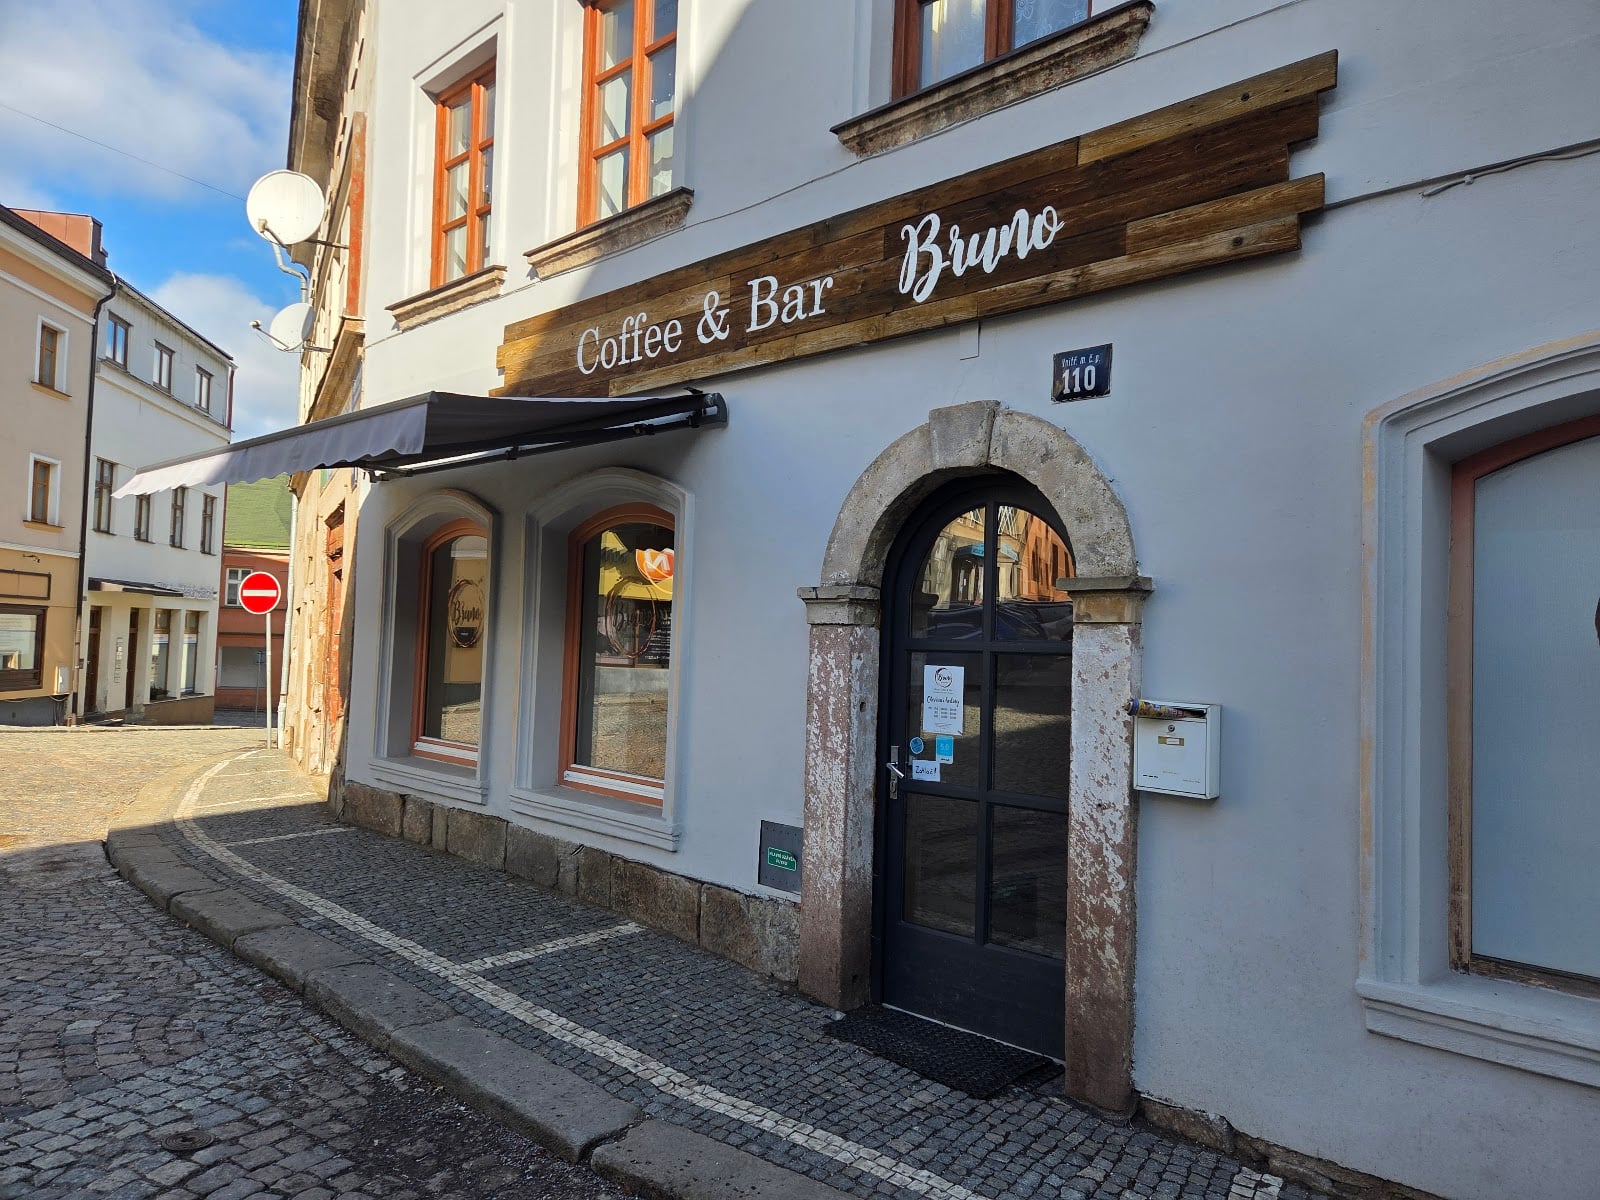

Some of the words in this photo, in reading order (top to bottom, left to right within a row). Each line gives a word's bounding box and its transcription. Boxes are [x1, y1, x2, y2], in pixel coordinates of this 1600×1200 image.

[576, 312, 682, 375] Coffee
[696, 291, 730, 344] &
[747, 275, 833, 333] Bar
[898, 205, 1065, 303] Bruno
[1062, 365, 1096, 394] 110
